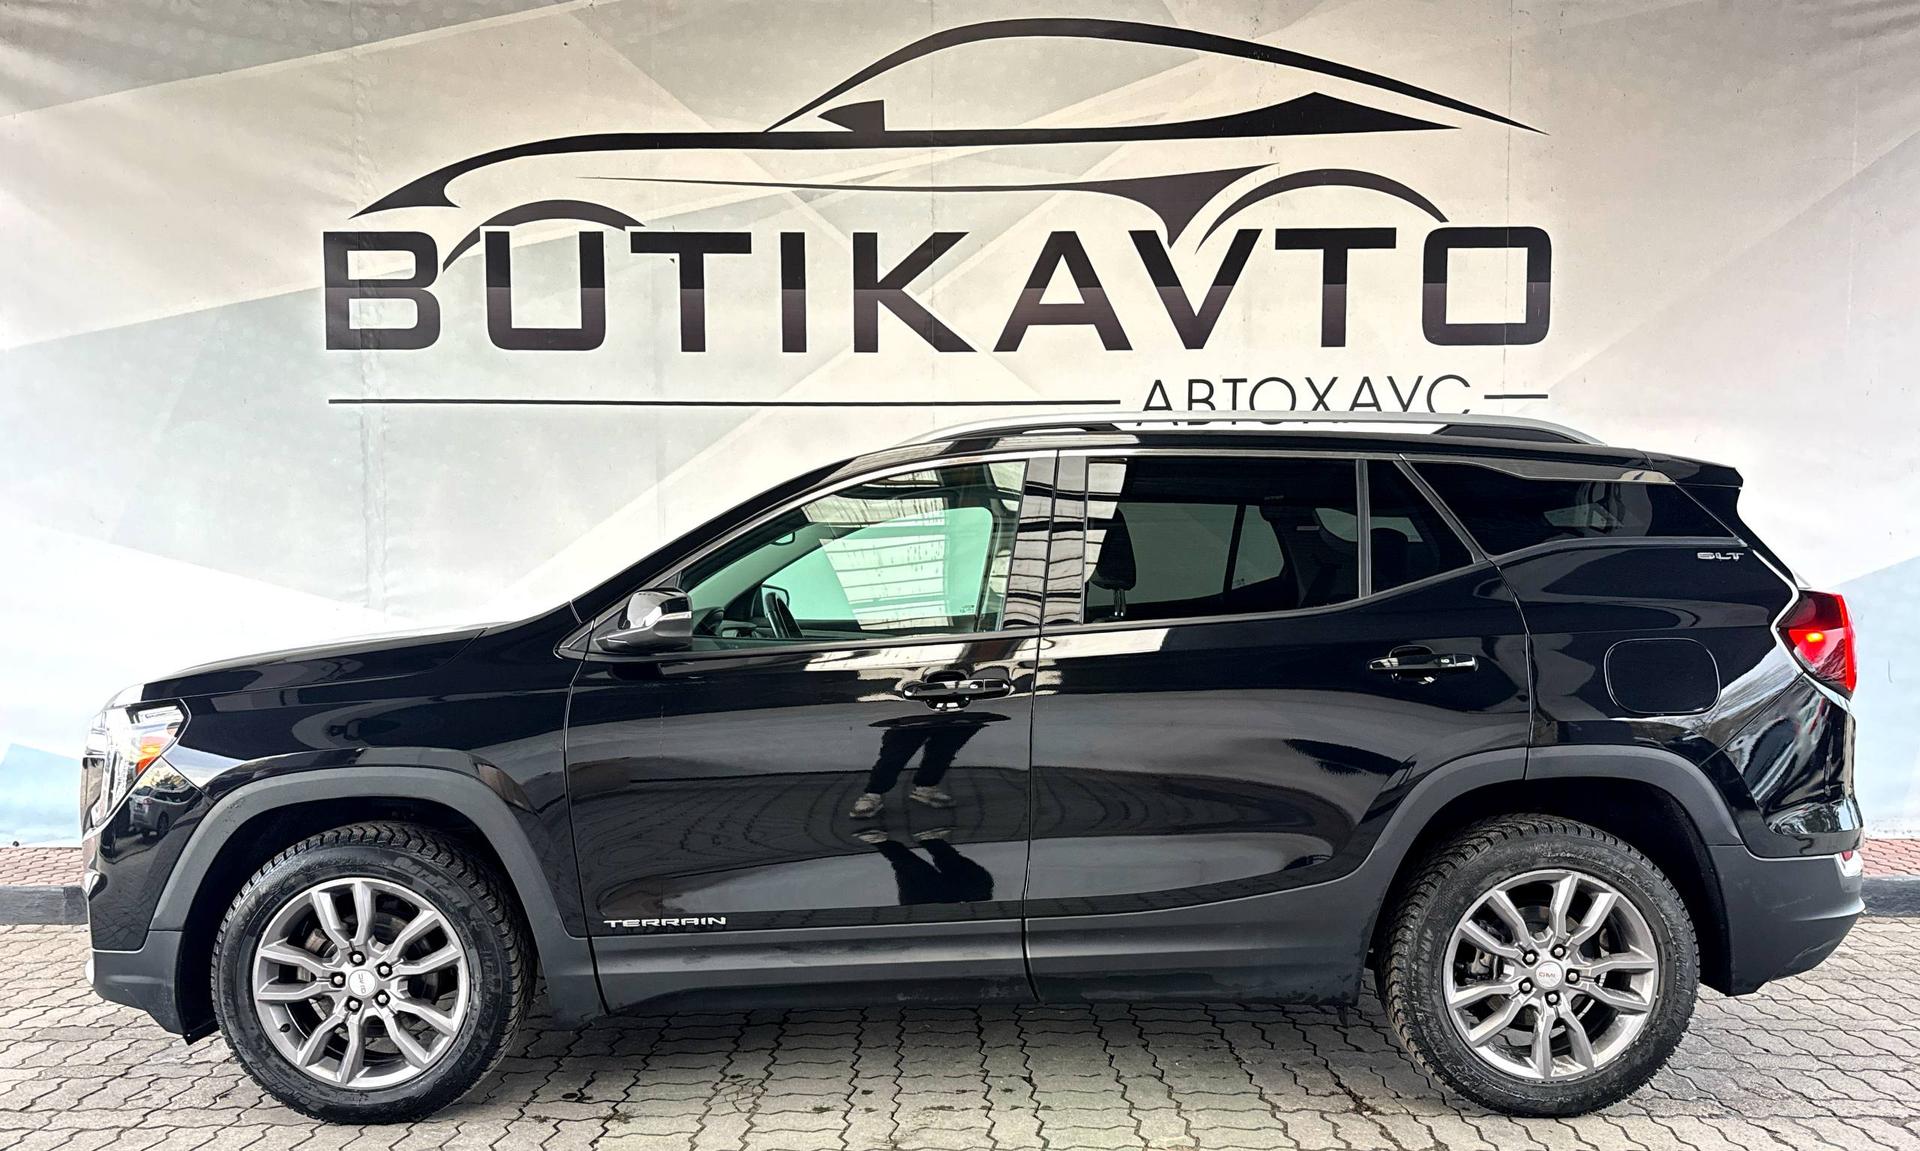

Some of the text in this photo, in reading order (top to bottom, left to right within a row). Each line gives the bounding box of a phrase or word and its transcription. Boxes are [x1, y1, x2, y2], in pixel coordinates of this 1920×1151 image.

[324, 226, 1552, 353] BUTIKAVTO
[1697, 552, 1745, 561] SLT
[603, 916, 727, 928] TERRAIN
